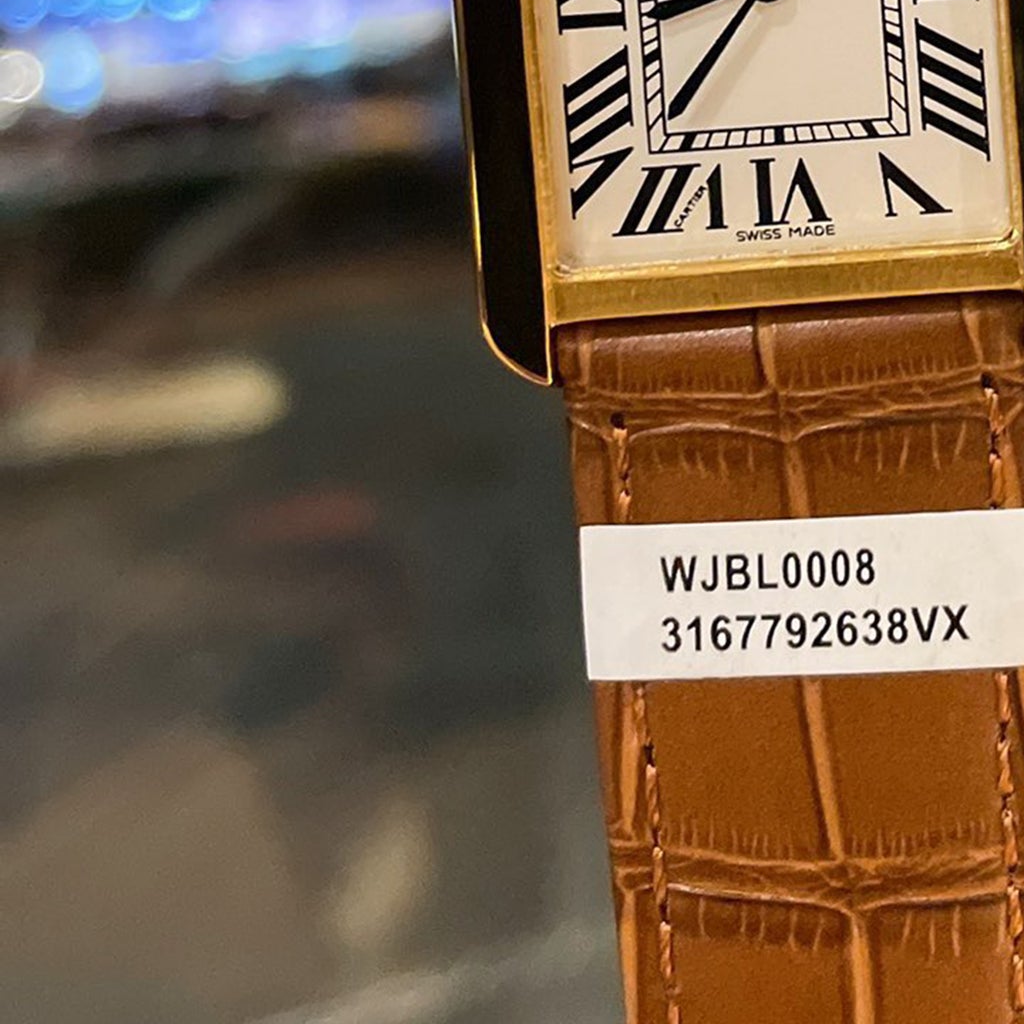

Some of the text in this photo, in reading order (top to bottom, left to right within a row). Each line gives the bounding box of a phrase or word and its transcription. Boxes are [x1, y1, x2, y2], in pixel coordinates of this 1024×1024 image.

[673, 184, 707, 228] CARTIER
[736, 223, 836, 242] SWISS MADE
[661, 549, 876, 593] WJBL0008
[661, 604, 970, 653] 3167792638VX
